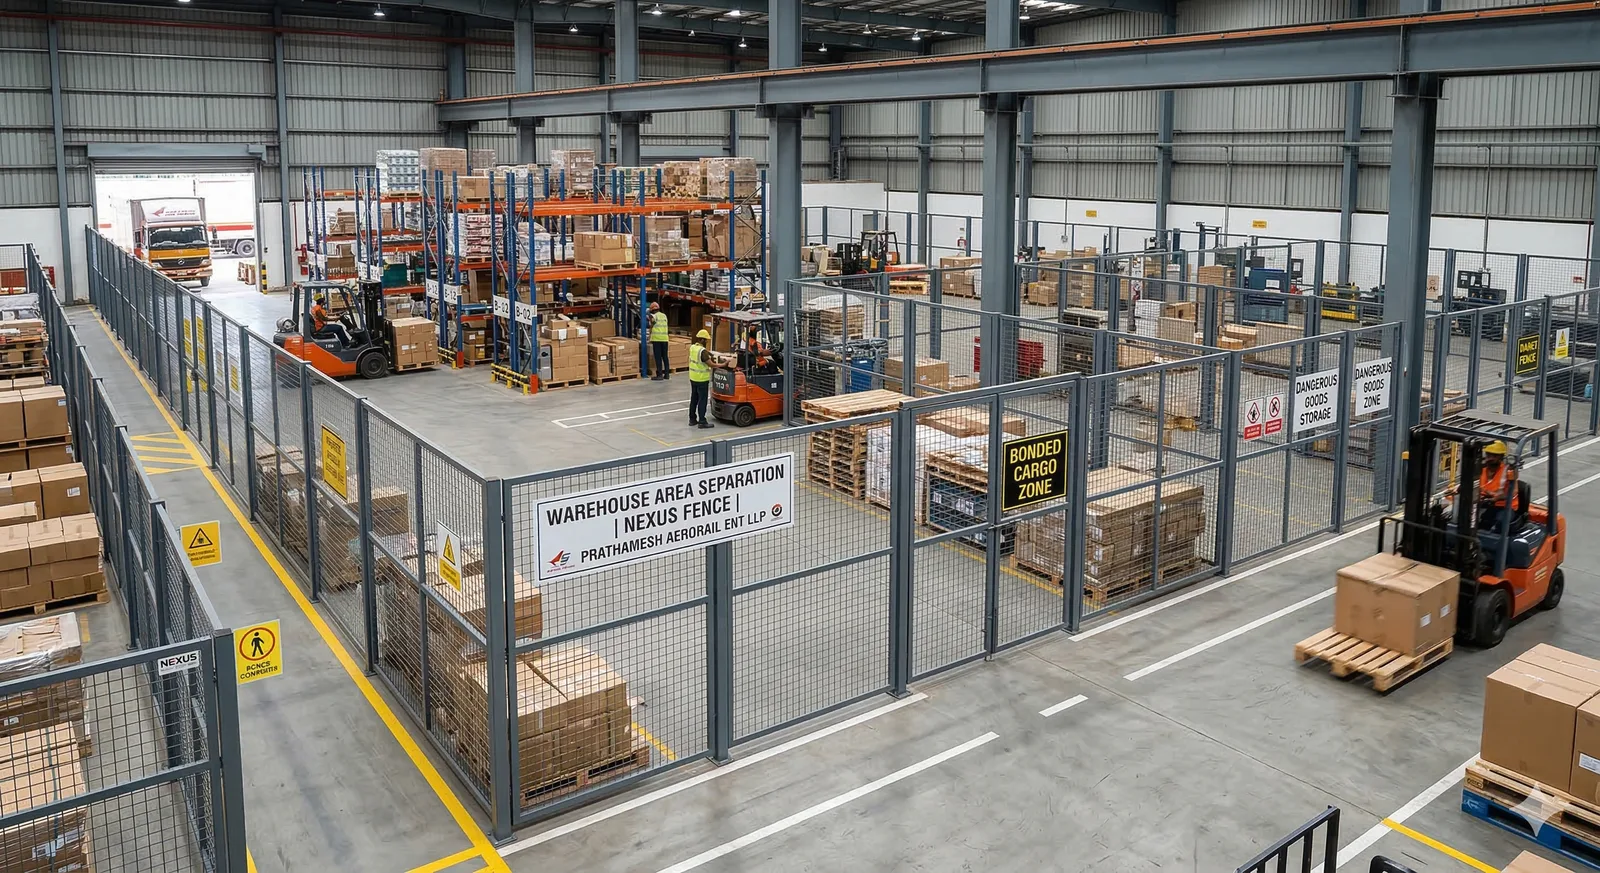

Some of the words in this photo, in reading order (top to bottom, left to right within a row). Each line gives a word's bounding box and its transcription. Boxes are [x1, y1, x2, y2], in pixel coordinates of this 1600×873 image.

[494, 300, 508, 313] B-02
[516, 306, 531, 320] B-02
[1355, 361, 1392, 379] DANGEROUS
[1295, 374, 1337, 394] DANGEROUS
[1363, 378, 1384, 393] GOODS
[1304, 392, 1328, 408] GOODS
[1363, 393, 1380, 408] ZONE
[1299, 407, 1331, 425] STORAGE
[1010, 439, 1061, 464] BONDED
[1013, 458, 1057, 481] CARGO
[546, 490, 650, 526] WAREHOUSE
[654, 482, 694, 505] AREA
[698, 463, 784, 495] SEPARATION
[1018, 478, 1052, 500] ZONE
[624, 506, 678, 533] NEXUS
[683, 495, 730, 520] FENCE
[581, 533, 662, 562] PRATHAMESH
[666, 519, 721, 544] AERORAIL
[724, 515, 744, 530] ENT
[747, 510, 766, 525] LLP
[160, 652, 197, 668] NEXUS
